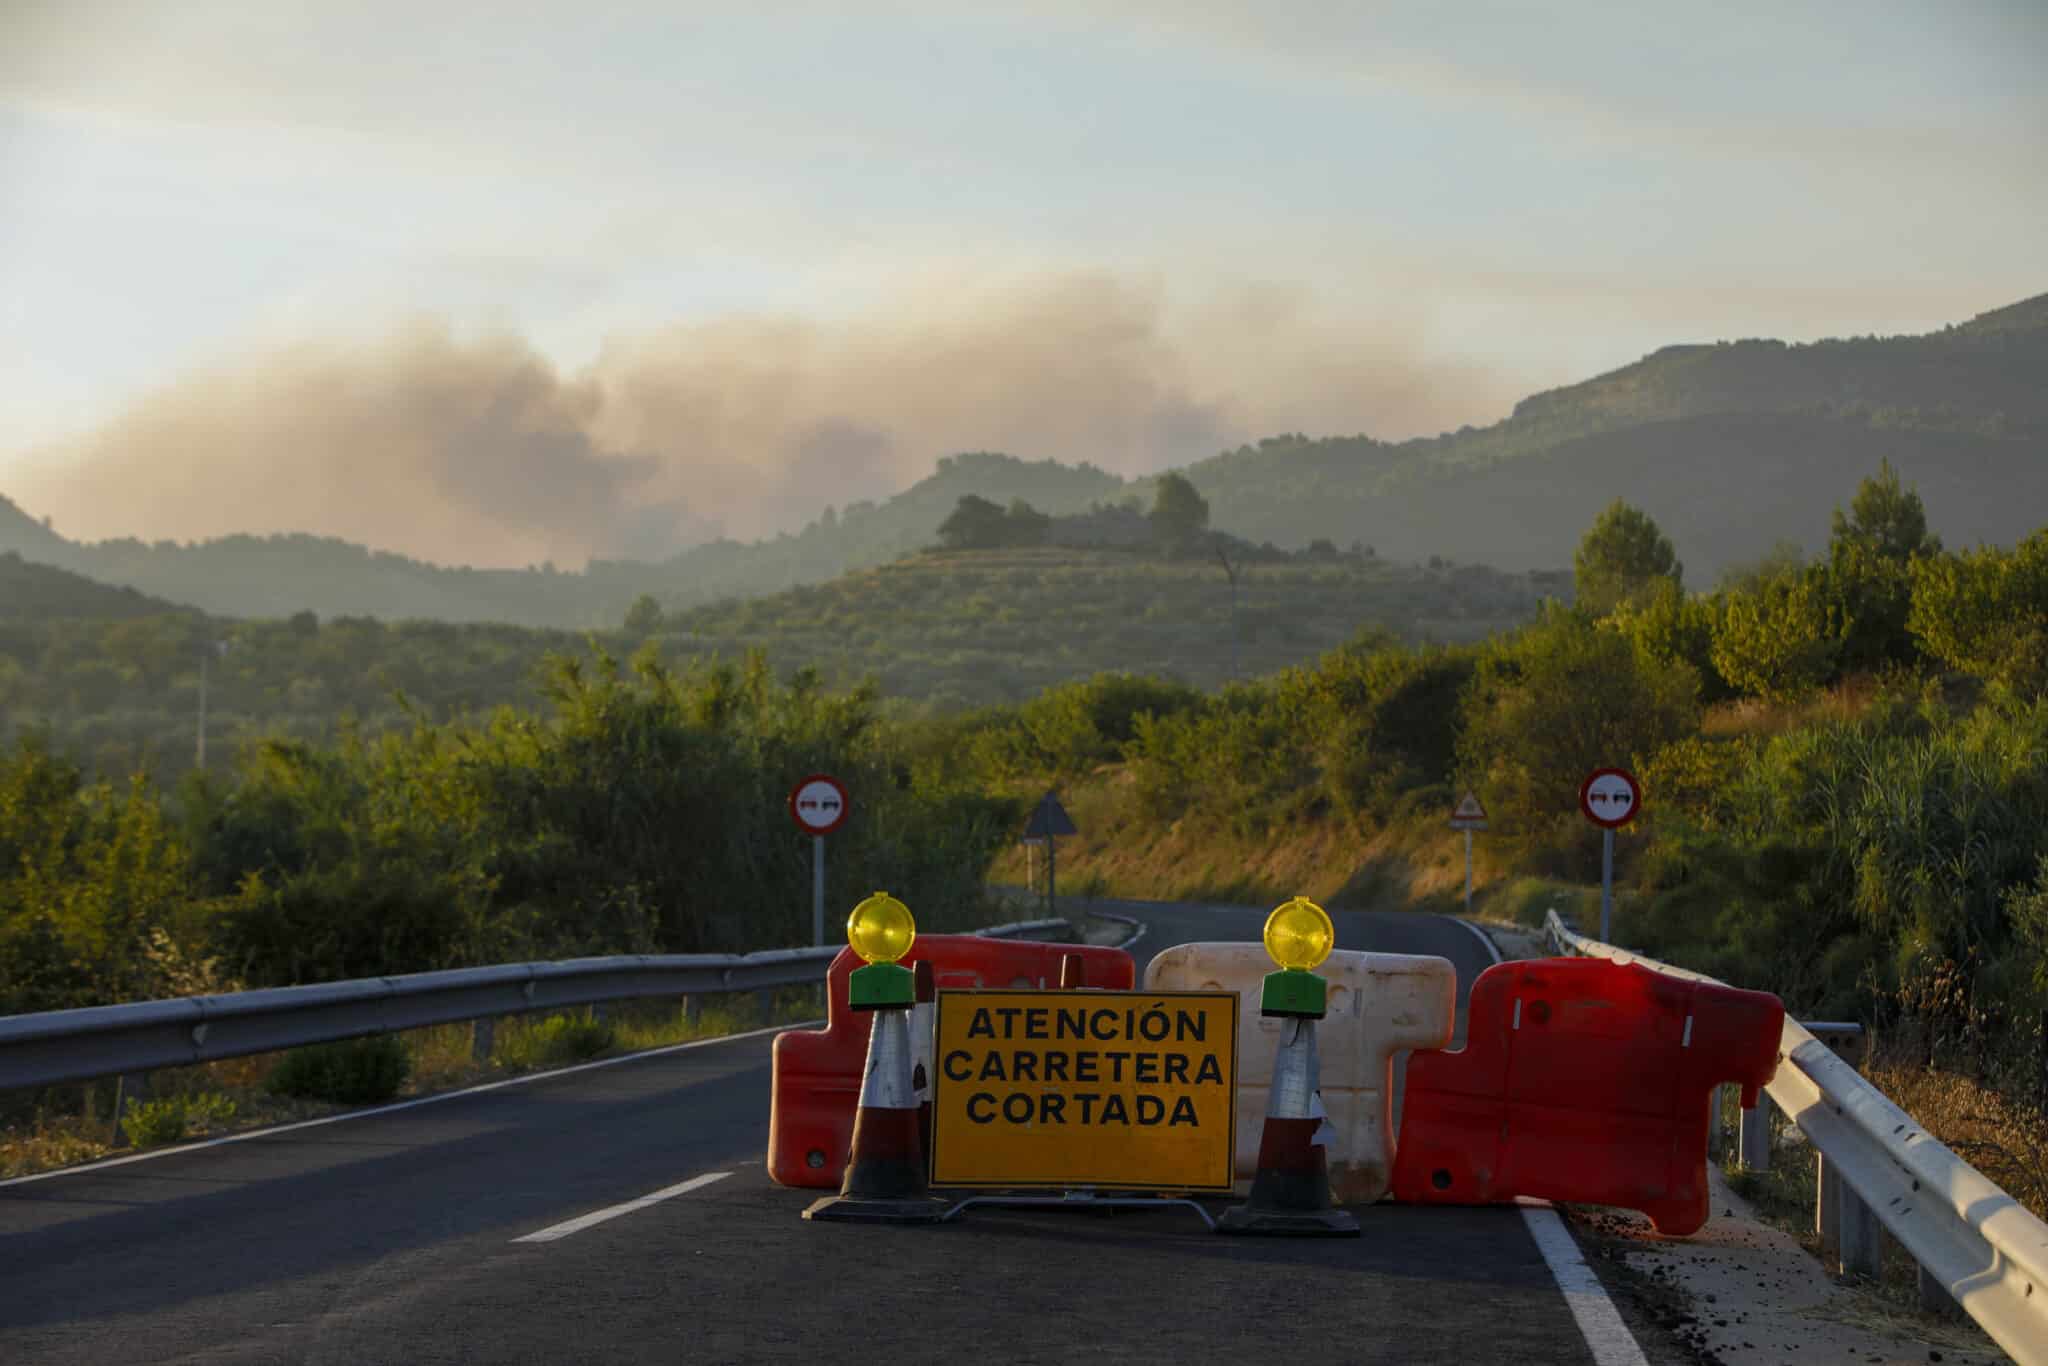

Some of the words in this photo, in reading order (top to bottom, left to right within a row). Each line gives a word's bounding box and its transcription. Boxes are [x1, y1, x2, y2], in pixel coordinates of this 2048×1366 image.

[967, 1002, 1206, 1041] ATENCIÓN
[943, 1050, 1223, 1085] CARRETERA
[966, 1092, 1199, 1127] CORTADA
